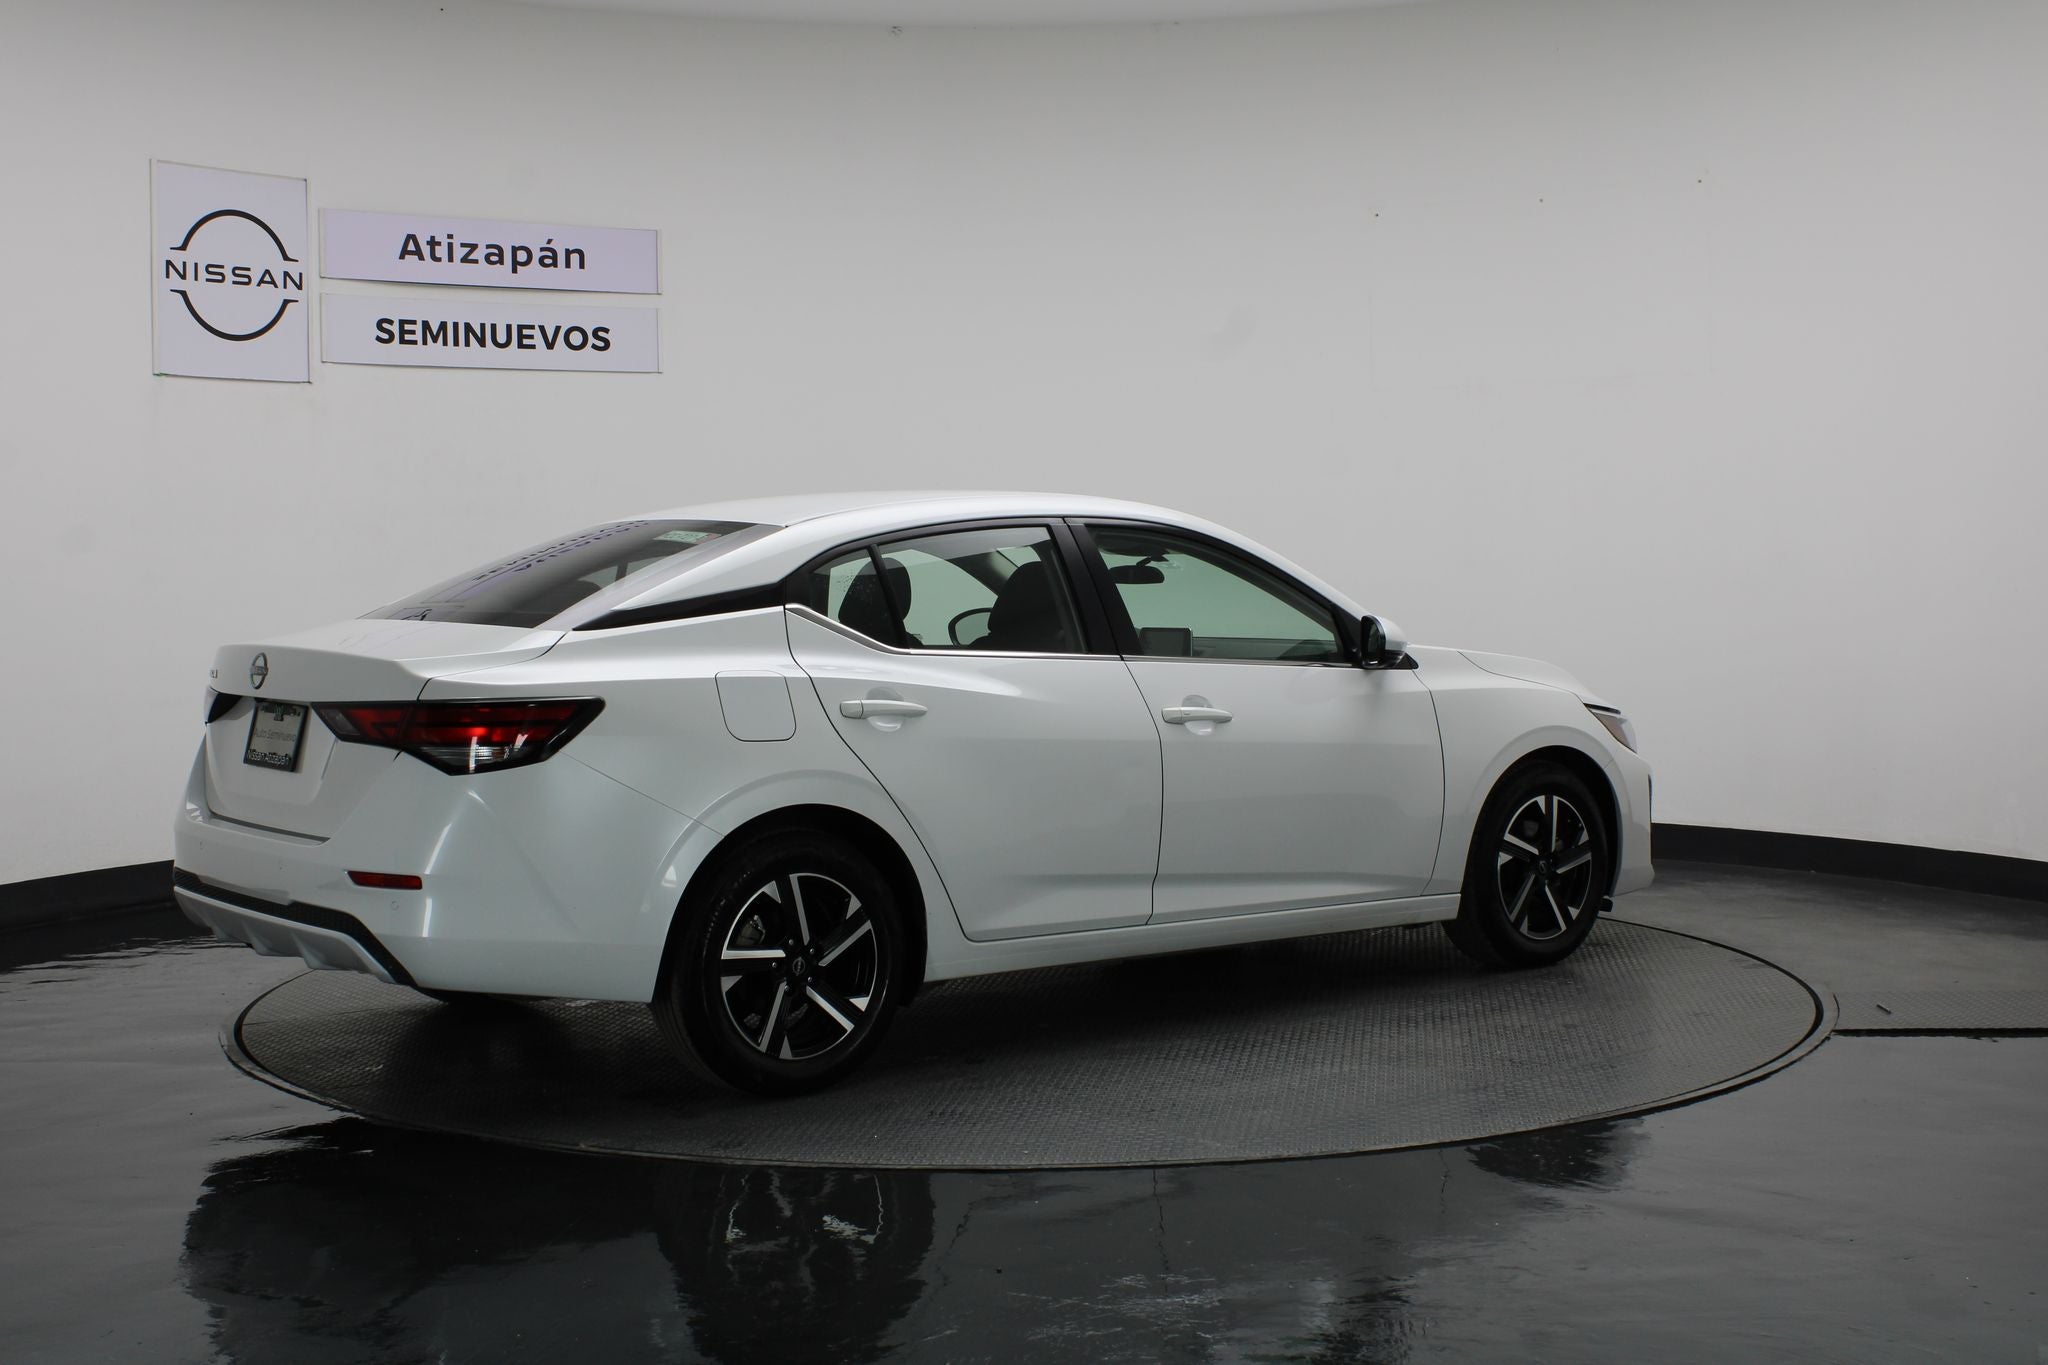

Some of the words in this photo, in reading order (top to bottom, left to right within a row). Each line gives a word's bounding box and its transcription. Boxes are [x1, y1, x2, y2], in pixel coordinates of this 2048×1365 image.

[398, 233, 586, 275] Atizapán
[165, 259, 303, 291] NISSAN
[375, 317, 611, 352] SEMINUEVOS
